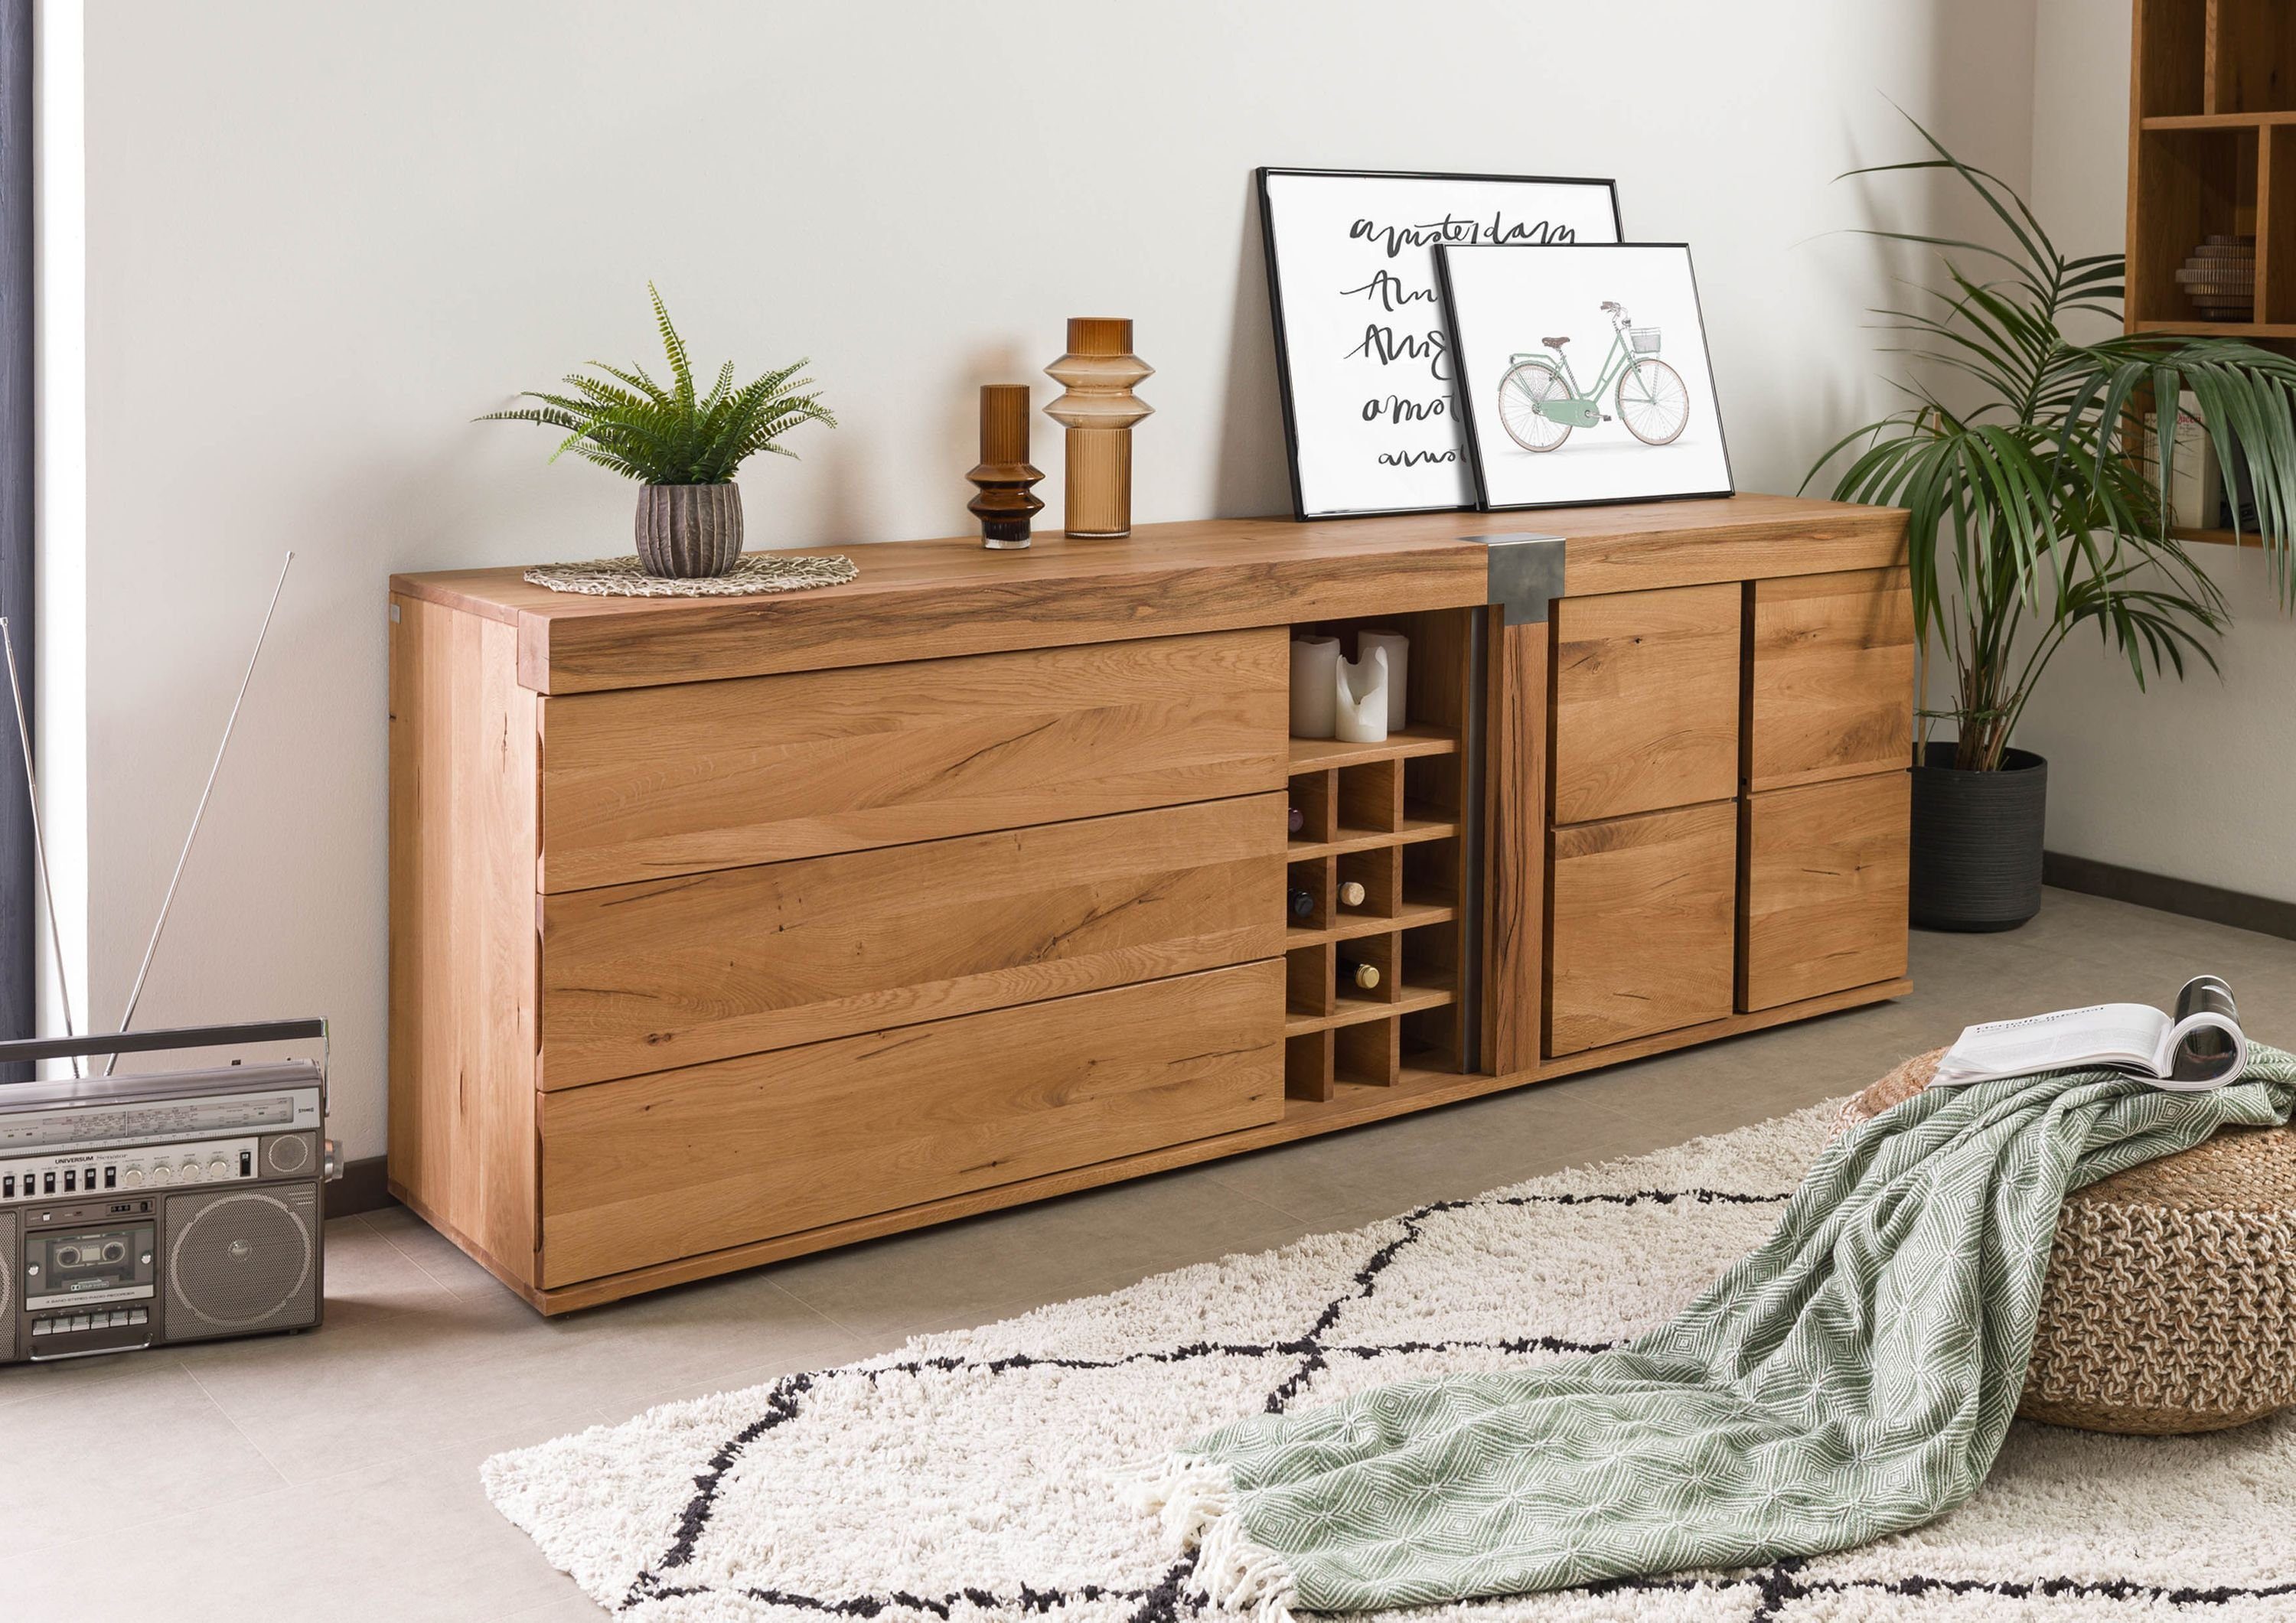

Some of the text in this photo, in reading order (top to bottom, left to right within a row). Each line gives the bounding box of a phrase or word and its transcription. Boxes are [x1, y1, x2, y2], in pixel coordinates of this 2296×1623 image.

[1349, 210, 1575, 258] amsterdam
[1339, 269, 1438, 312] Am
[1343, 324, 1453, 381] Ams
[1362, 391, 1460, 425] amst
[54, 1155, 94, 1165] UNIVERSUM
